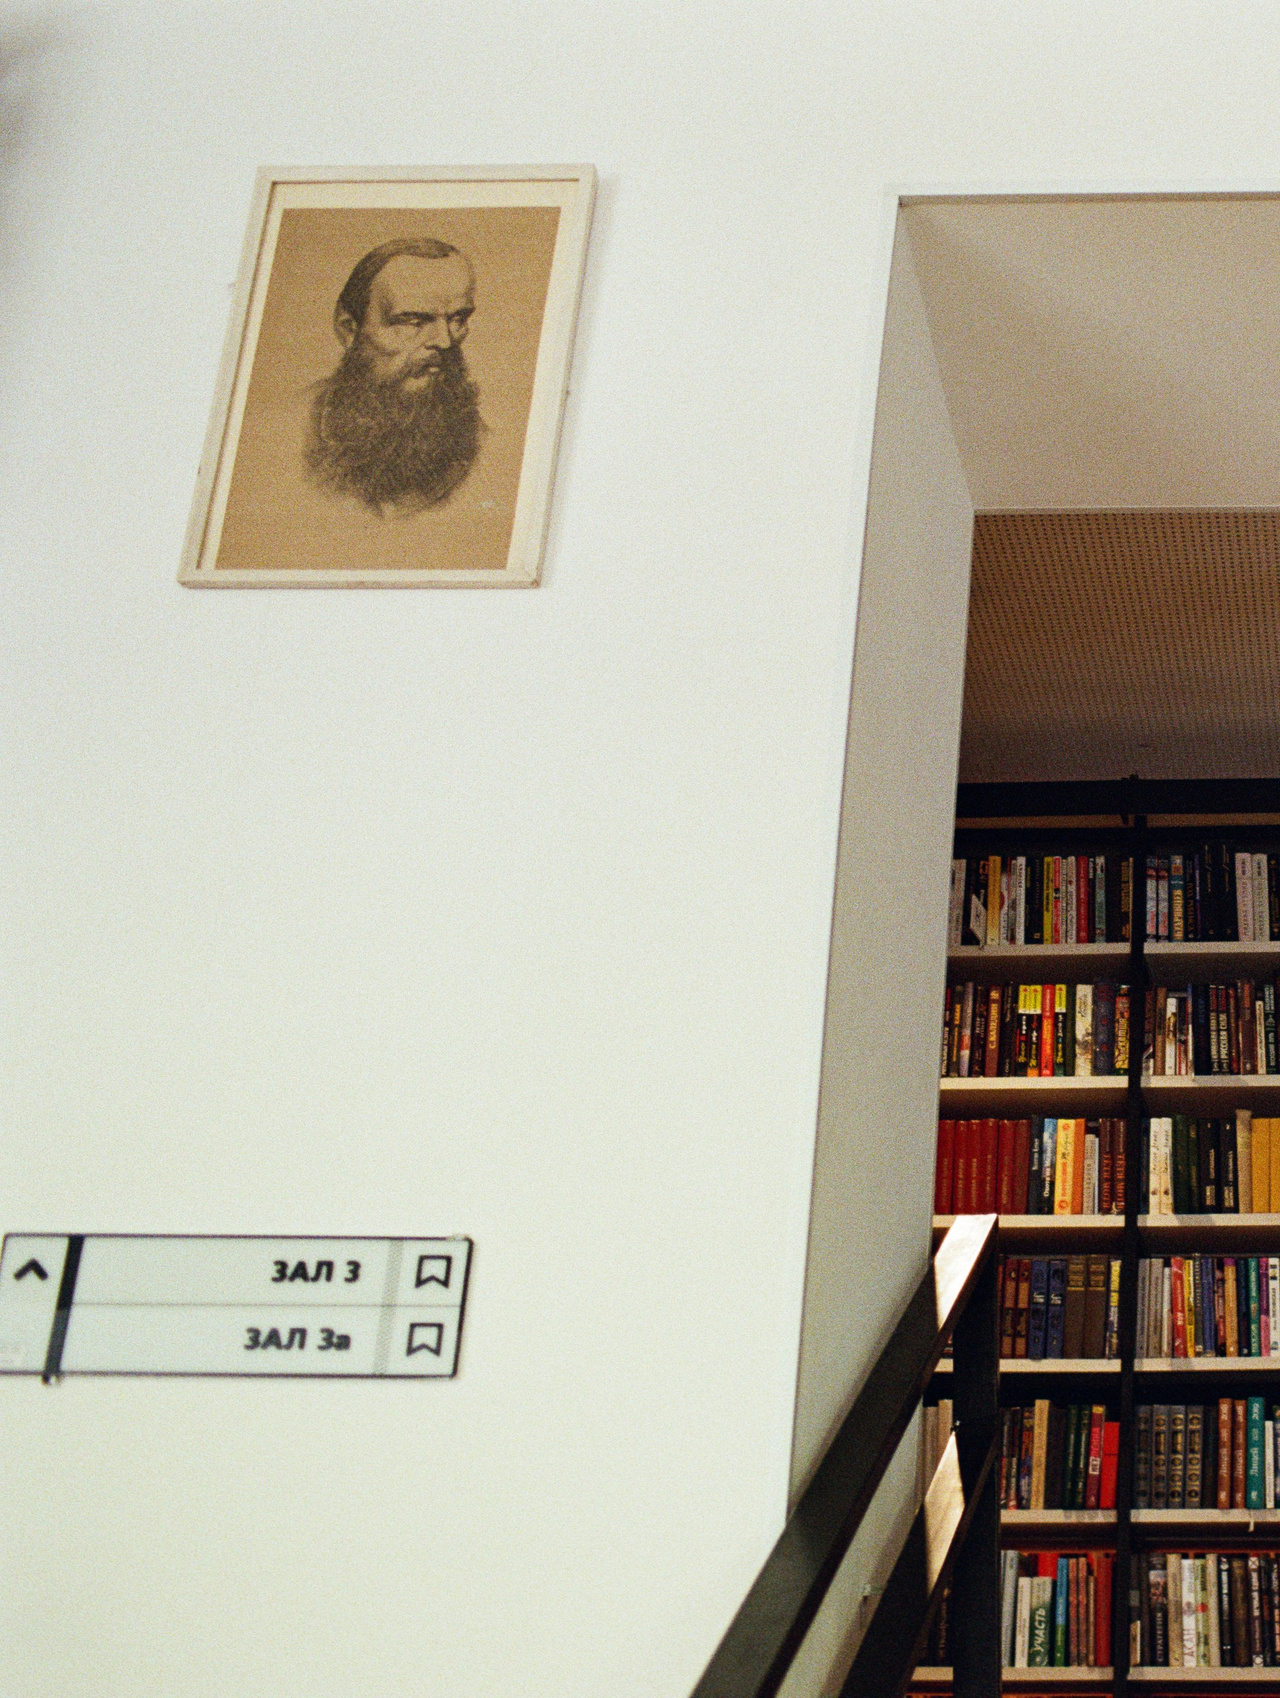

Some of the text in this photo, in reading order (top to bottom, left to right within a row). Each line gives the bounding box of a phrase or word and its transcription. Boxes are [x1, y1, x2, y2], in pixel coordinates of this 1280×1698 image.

[272, 1260, 361, 1283] ЗАЛ 3
[245, 1328, 307, 1350] ЗАЛ
[1029, 1606, 1048, 1653] УЧАСТЬ
